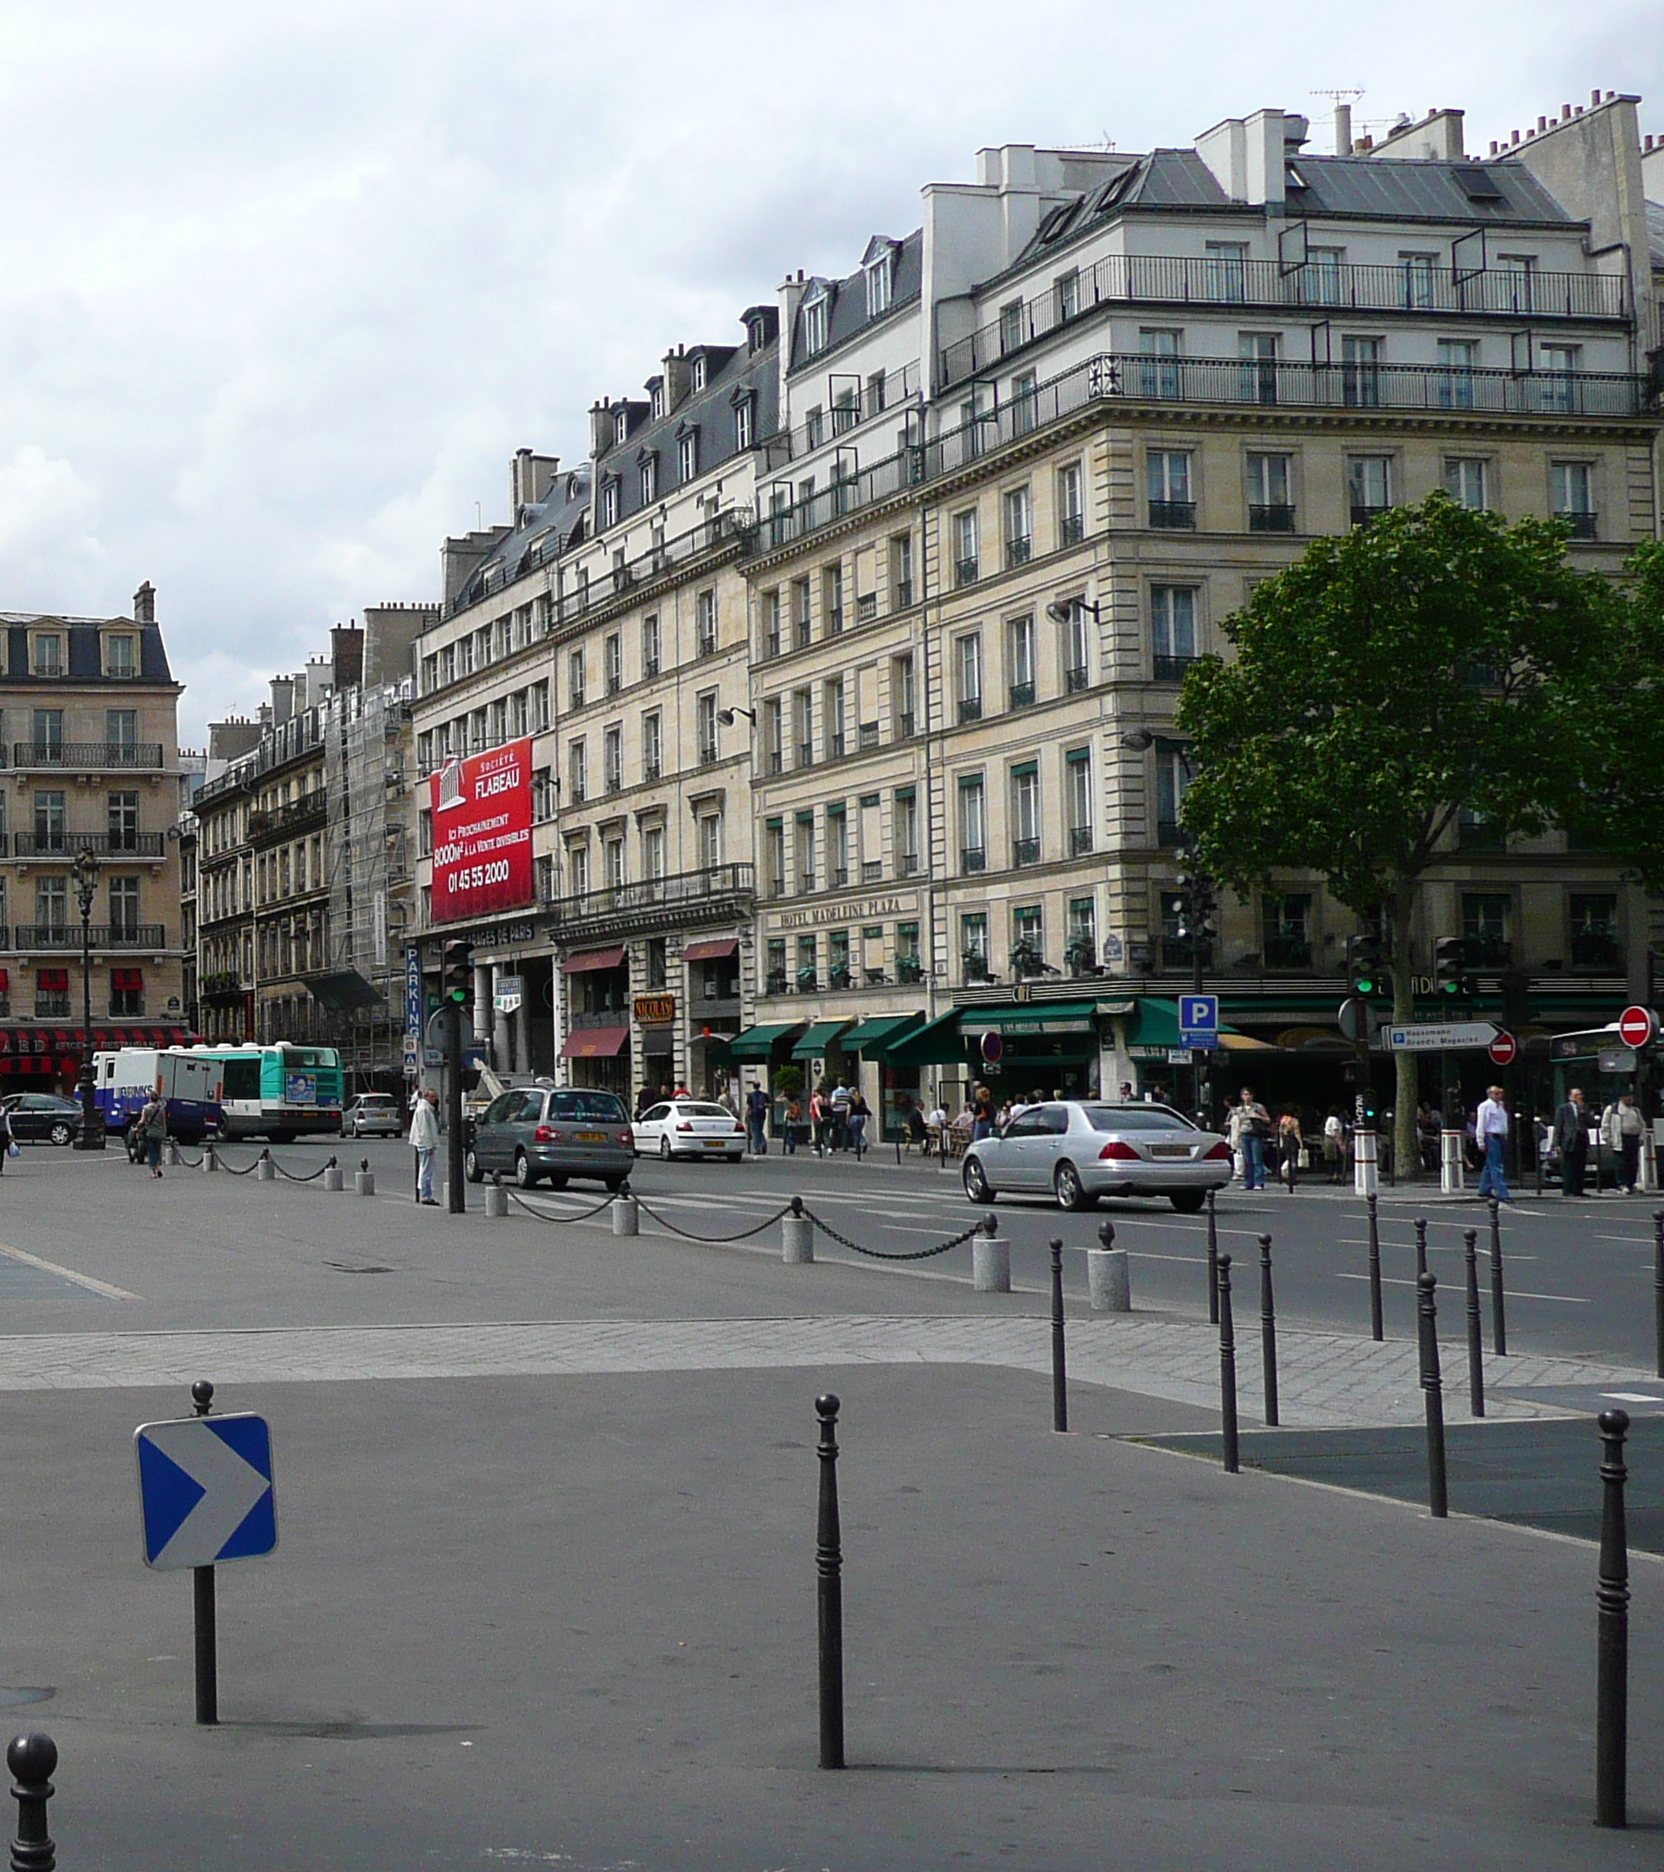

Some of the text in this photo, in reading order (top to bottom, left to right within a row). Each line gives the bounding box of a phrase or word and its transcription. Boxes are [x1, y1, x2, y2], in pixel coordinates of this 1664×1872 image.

[480, 751, 515, 773] SOCIÉTÉ
[475, 768, 520, 800] FLABEAU
[457, 812, 510, 839] PROCHAINEMENT
[448, 858, 510, 893] 01 45 55 2000
[780, 897, 901, 929] HOTEL MADELEINE PLAZA
[497, 927, 509, 943] DE
[509, 924, 533, 941] PARIS
[407, 948, 421, 1037] PARKING
[635, 999, 671, 1018] NICOLAS
[1191, 1002, 1209, 1025] P
[100, 1040, 162, 1049] RESTAURANT
